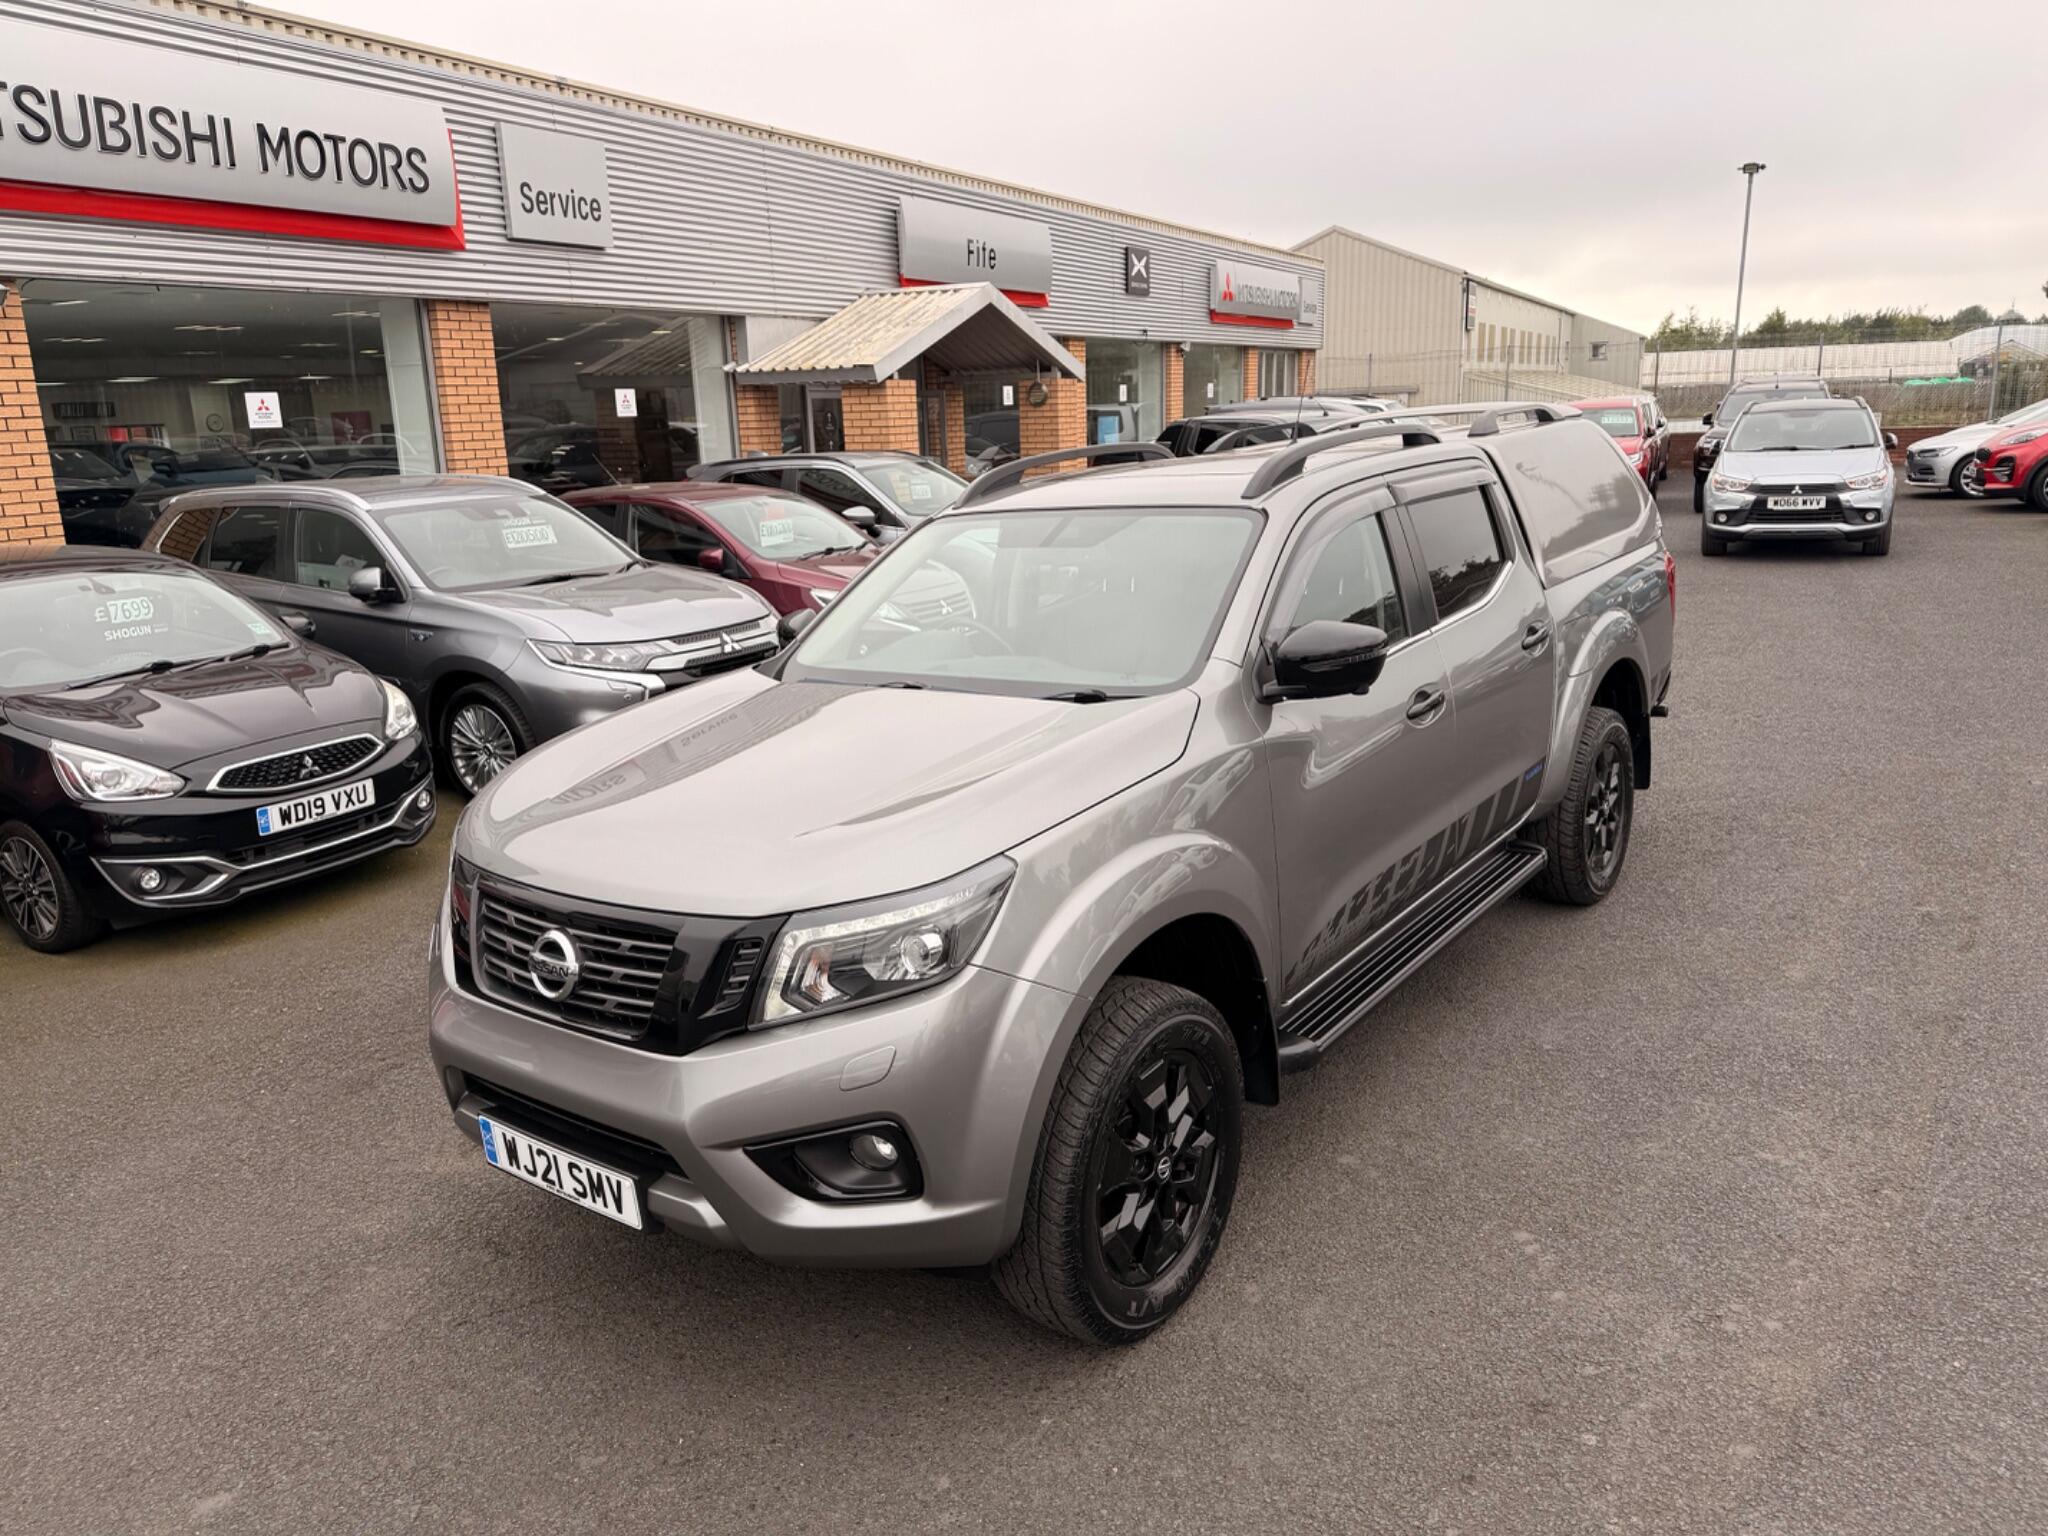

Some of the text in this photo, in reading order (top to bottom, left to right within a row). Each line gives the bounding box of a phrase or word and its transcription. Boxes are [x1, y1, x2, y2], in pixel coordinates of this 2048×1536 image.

[255, 121, 431, 194] MOTORS
[519, 181, 602, 222] Service
[966, 238, 997, 270] Fife
[94, 597, 152, 623] £7699
[104, 624, 152, 641] SHOGUN
[279, 784, 368, 826] WD19 VXU
[502, 1131, 624, 1215] WJ21 SMV
